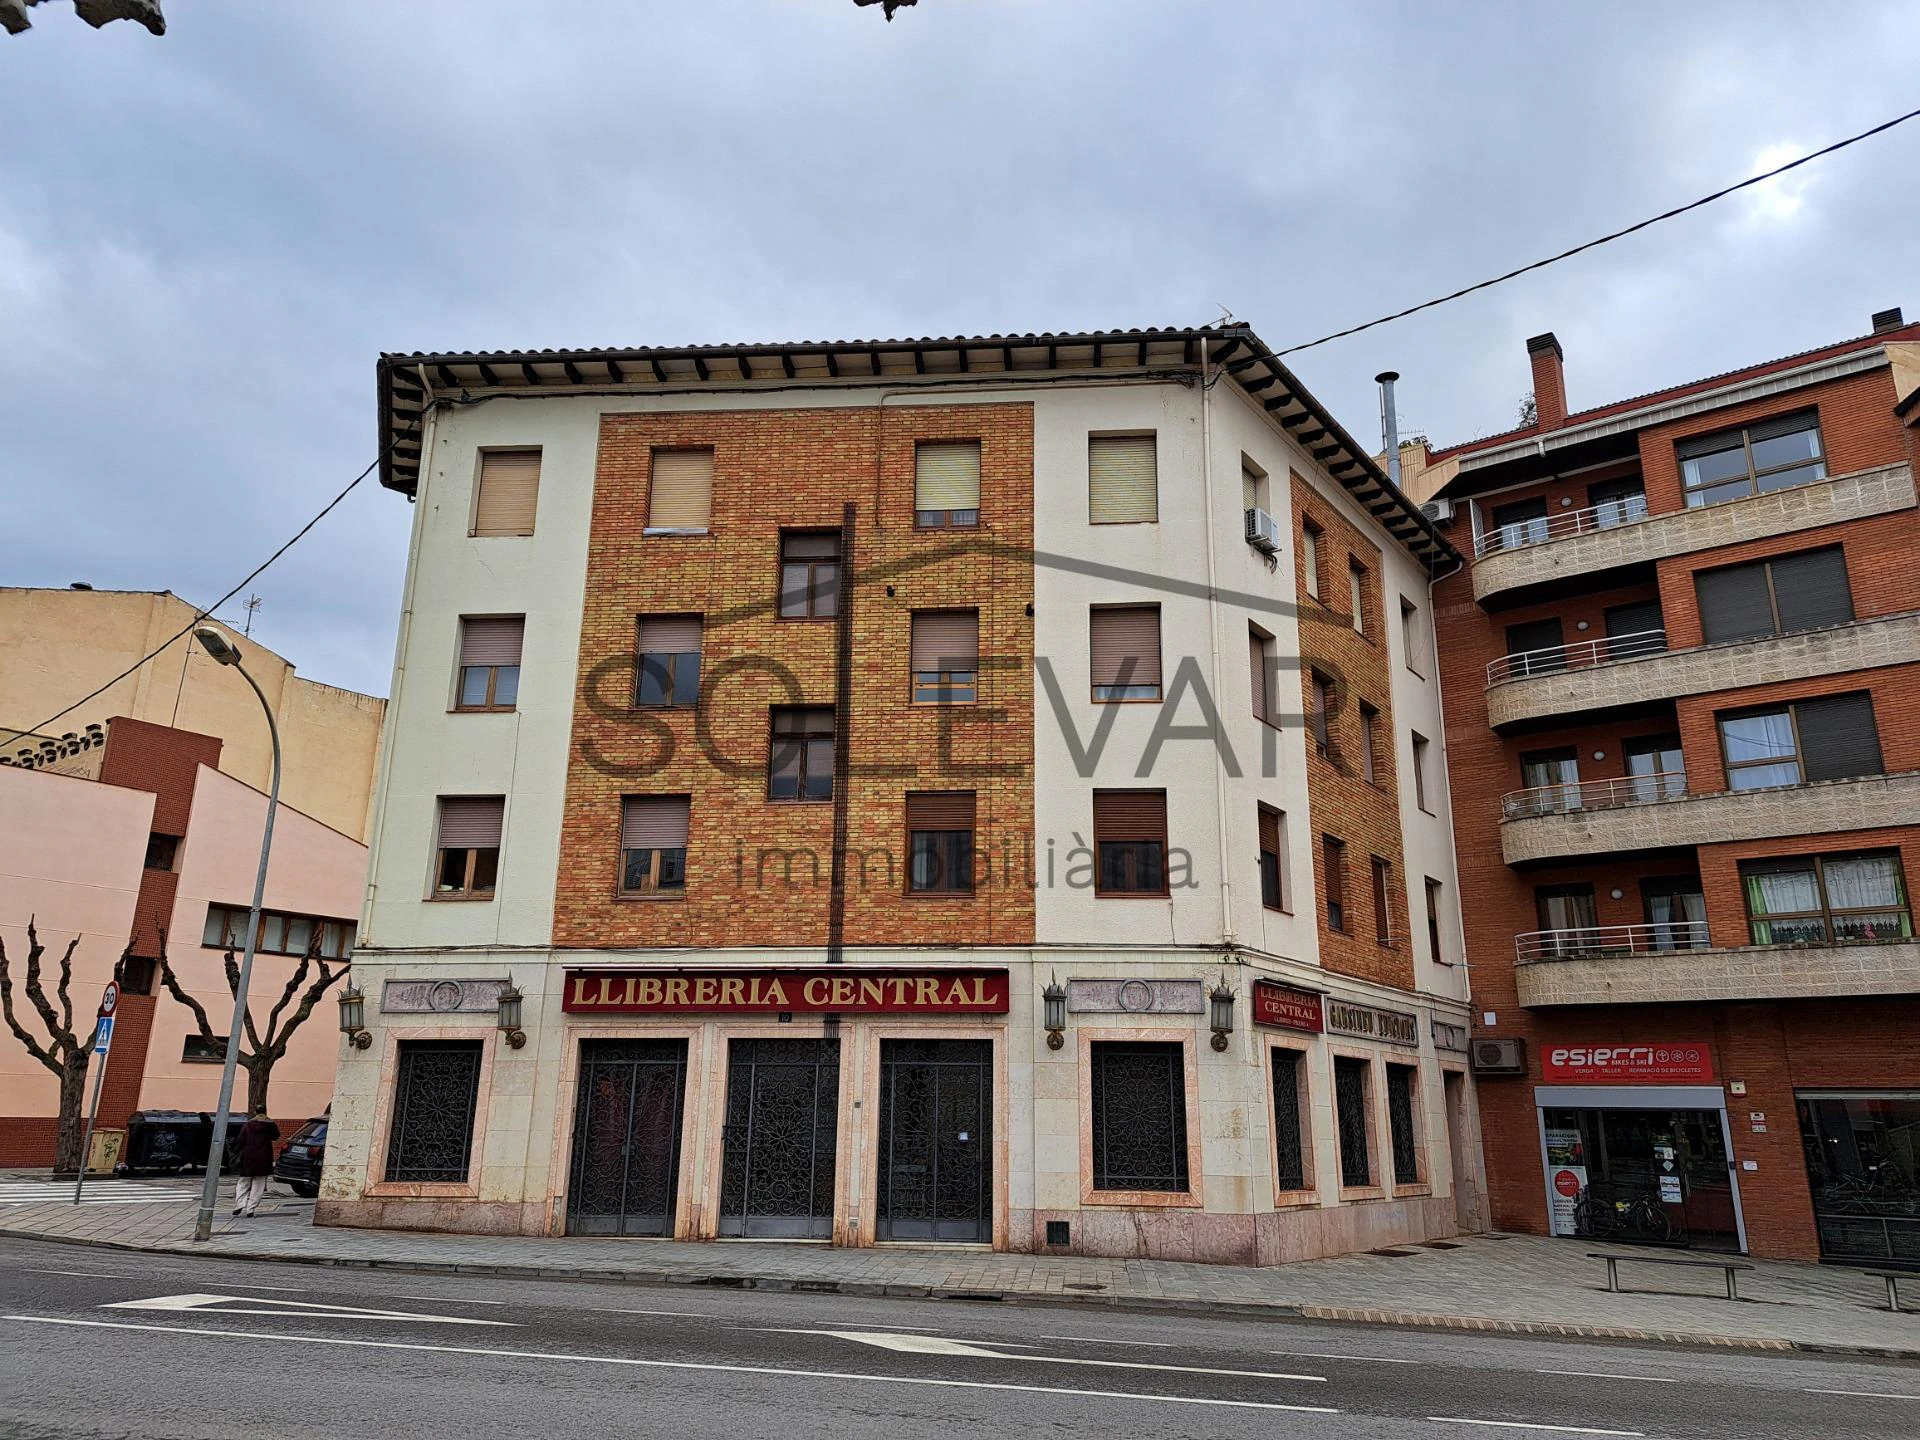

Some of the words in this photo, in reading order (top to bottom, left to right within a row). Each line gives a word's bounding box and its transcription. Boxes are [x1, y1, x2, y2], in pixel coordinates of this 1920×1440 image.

[104, 992, 115, 1005] 30
[571, 977, 790, 1006] LLIBRERIA
[803, 977, 999, 1006] CENTRAL
[1260, 986, 1319, 1009] LLIBRERIA
[1264, 1000, 1316, 1020] CENTRAL
[1551, 1048, 1653, 1066] esierri
